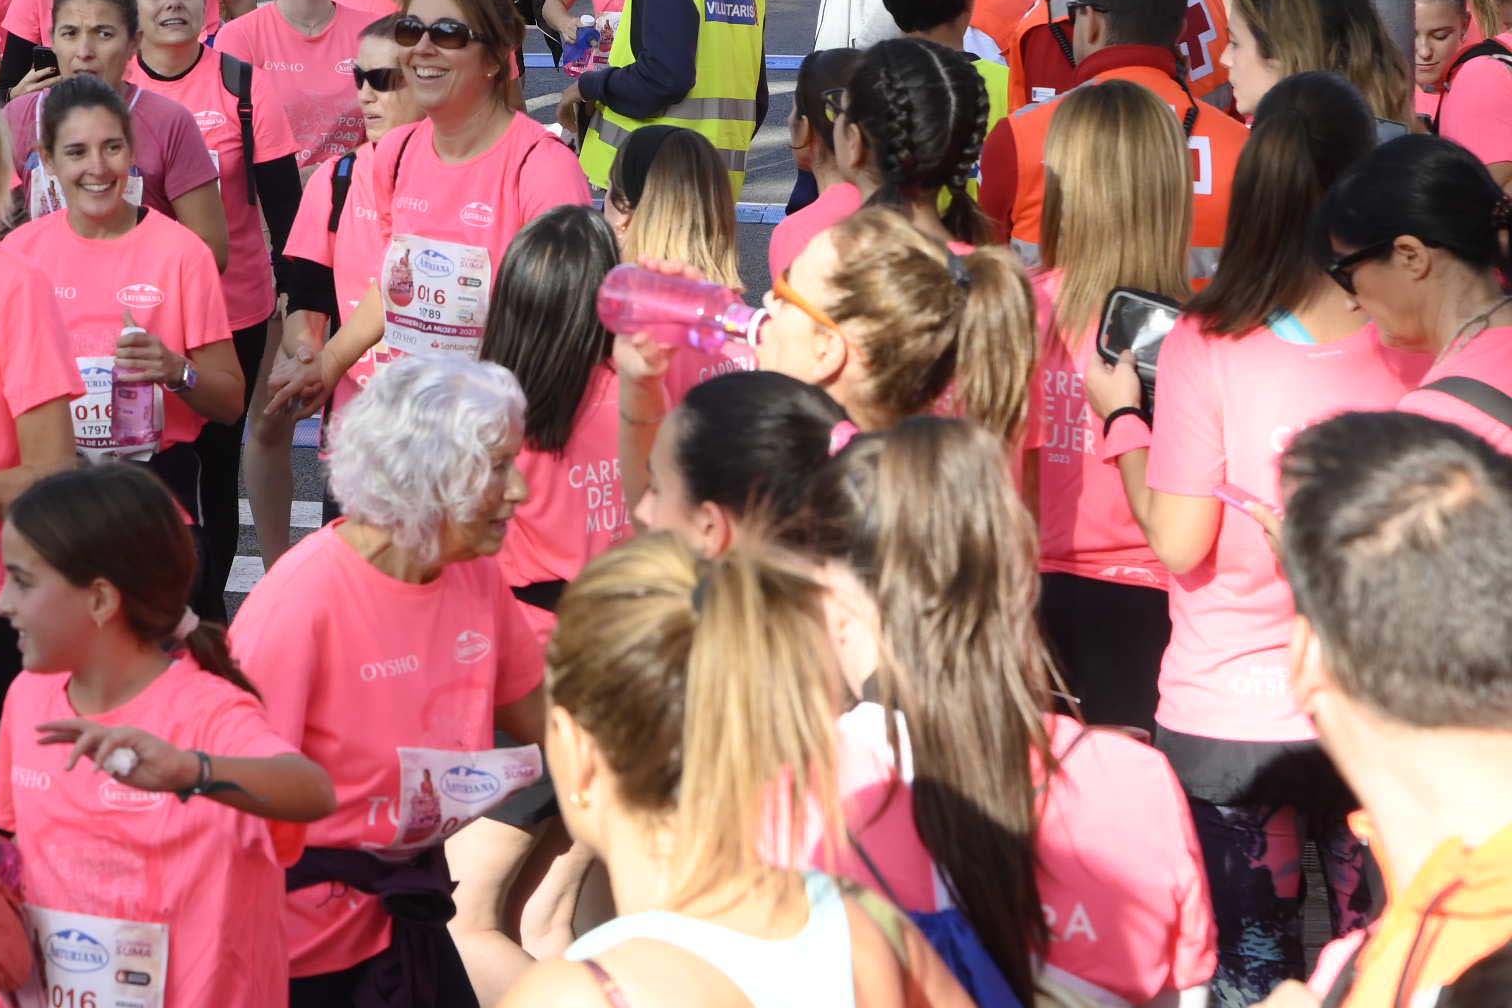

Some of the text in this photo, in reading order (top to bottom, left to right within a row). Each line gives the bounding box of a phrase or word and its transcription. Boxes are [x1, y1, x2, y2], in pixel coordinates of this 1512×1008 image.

[1065, 399, 1093, 427] LA
[587, 483, 613, 509] DE
[359, 654, 419, 682] OYSHO
